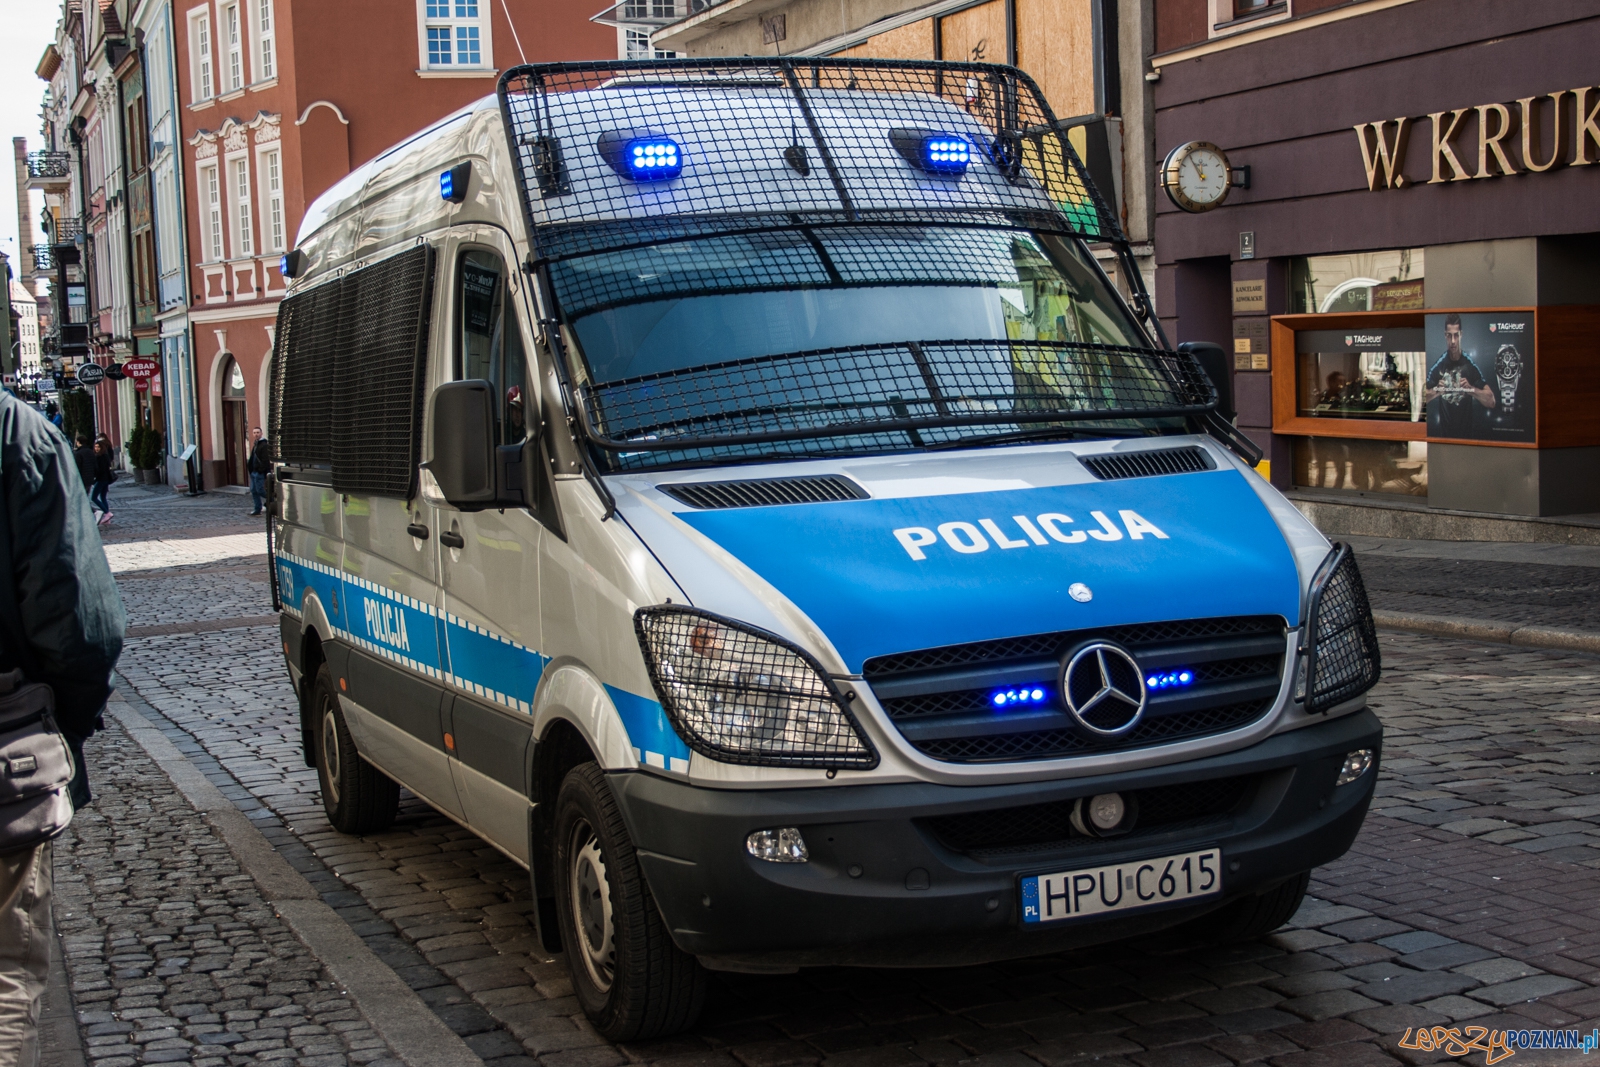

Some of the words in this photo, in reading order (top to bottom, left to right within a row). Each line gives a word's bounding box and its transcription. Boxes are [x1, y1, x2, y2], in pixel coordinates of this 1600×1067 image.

[1353, 117, 1407, 192] W.
[1427, 85, 1600, 184] KRUK
[1244, 236, 1249, 245] 2
[1235, 285, 1262, 293] KANCELARIE
[892, 509, 1170, 561] POLICJA
[363, 596, 411, 653] POLICJA
[1045, 868, 1122, 916] HPU
[1135, 853, 1216, 901] C615
[1024, 905, 1038, 917] PL
